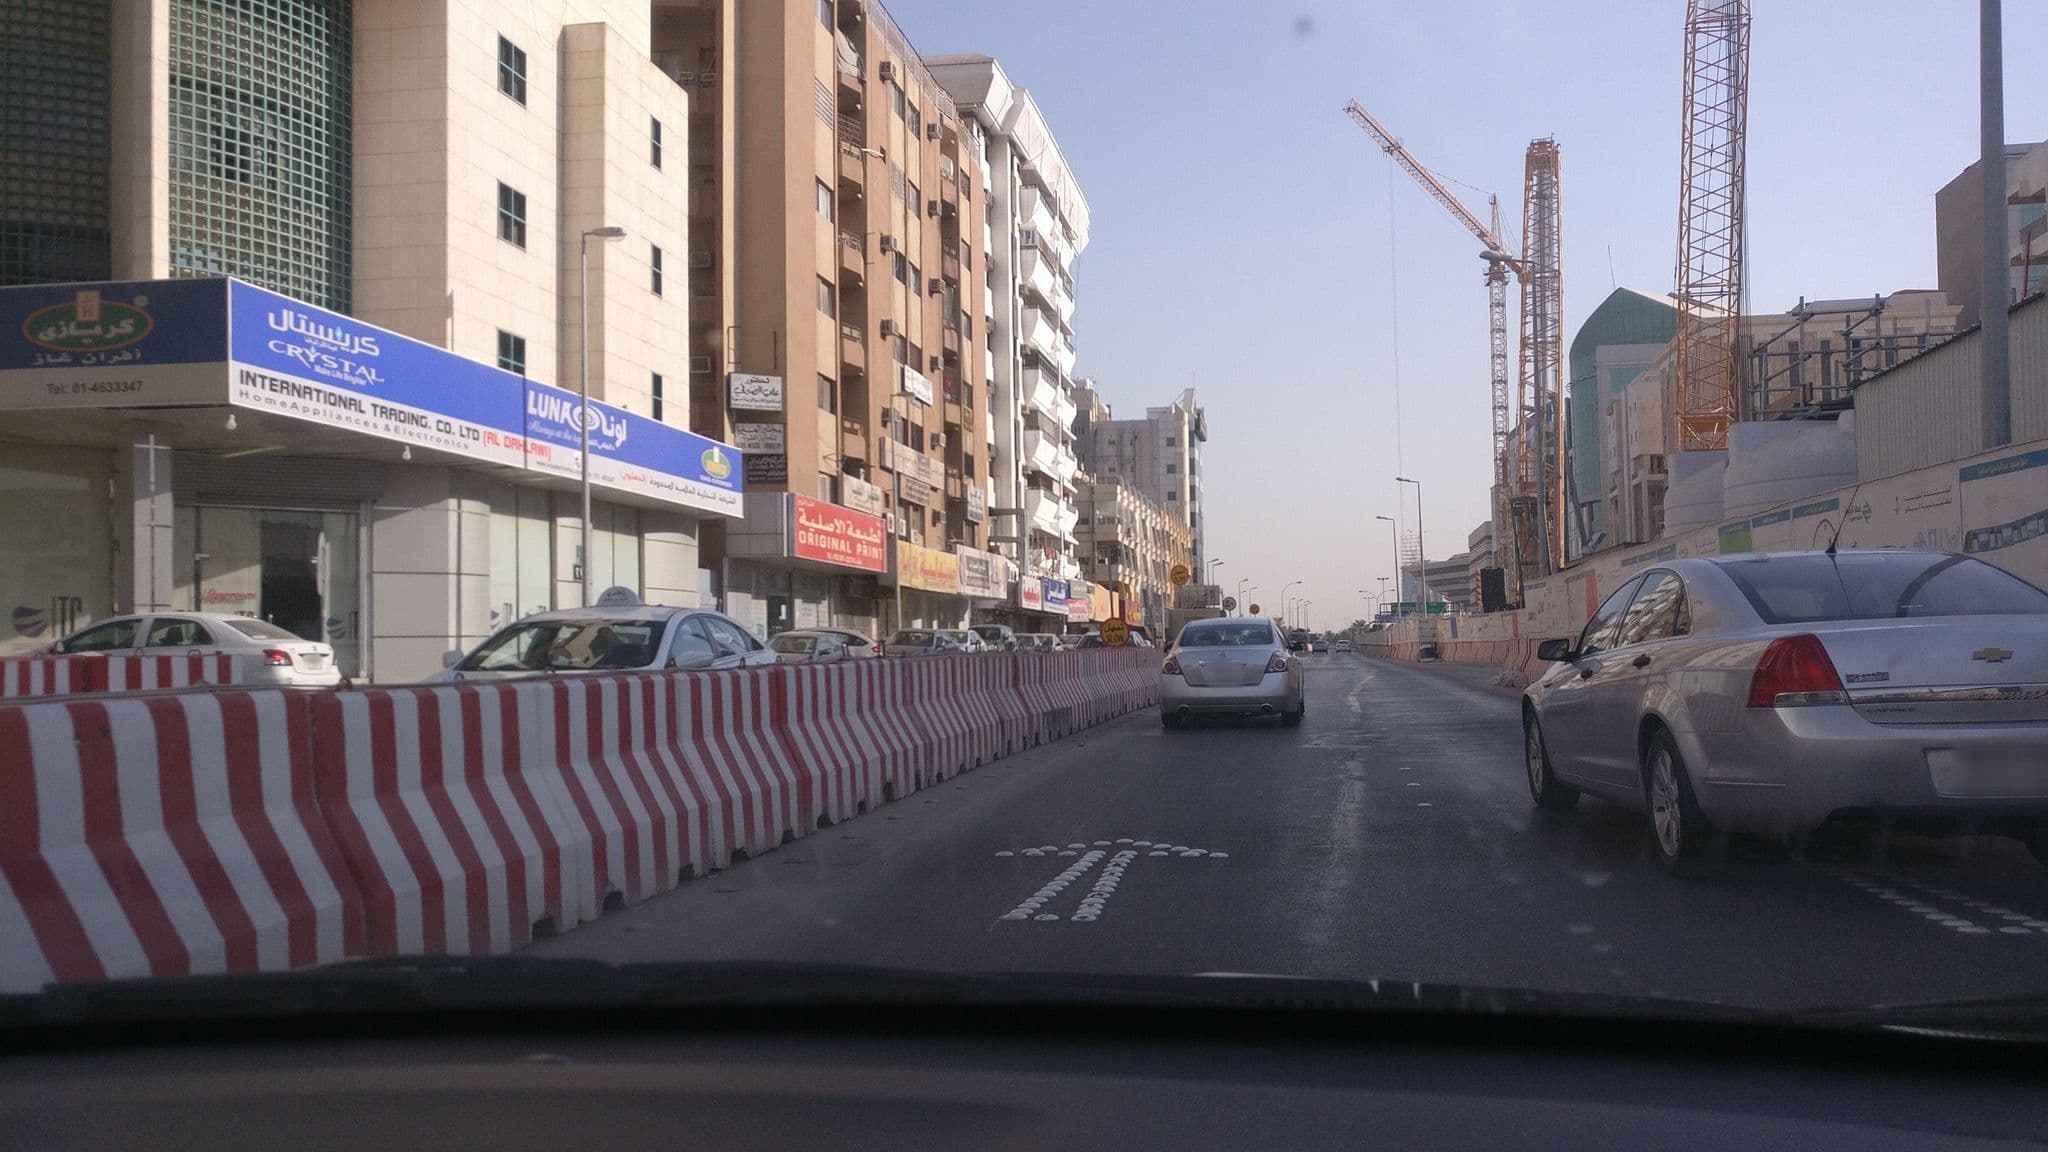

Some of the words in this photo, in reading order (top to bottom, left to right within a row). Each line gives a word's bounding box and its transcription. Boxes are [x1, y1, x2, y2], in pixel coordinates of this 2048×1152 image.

[268, 340, 385, 386] CRYSTAL
[239, 369, 367, 415] INTERNATIONAL
[371, 402, 432, 430] TRADING.
[436, 418, 456, 437] CO.
[459, 425, 481, 442] LTD
[527, 389, 572, 425] LUNA
[799, 530, 852, 554] ORIGINAL
[856, 542, 883, 562] PRINT
